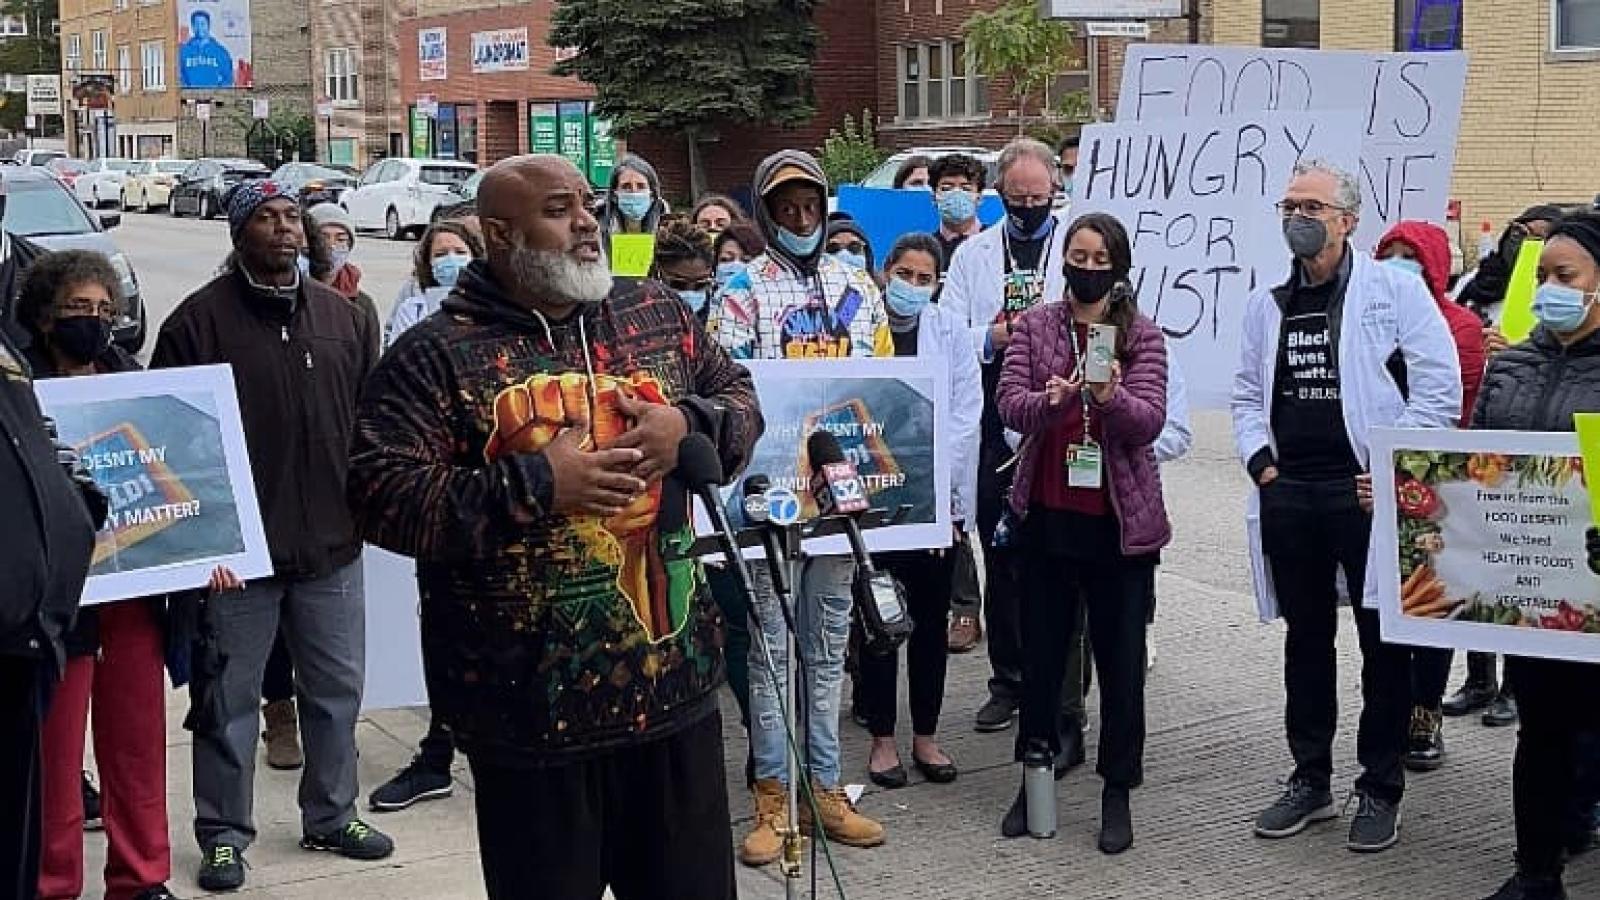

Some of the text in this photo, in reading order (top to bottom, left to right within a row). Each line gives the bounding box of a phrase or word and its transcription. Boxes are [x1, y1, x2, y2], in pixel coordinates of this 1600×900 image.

[1136, 55, 1431, 138] FOOD IS
[1086, 123, 1315, 200] HUNGRY
[1133, 211, 1236, 263] FOR
[862, 421, 885, 437] MY
[81, 444, 167, 470] OESNT MY
[858, 472, 906, 488] ATTER?
[1477, 489, 1501, 502] Free
[1518, 491, 1545, 504] from
[124, 499, 201, 526] MATTER?
[1485, 512, 1518, 523] FOOD
[1483, 551, 1575, 569] HEALTHY FOODS
[1515, 574, 1541, 587] AND
